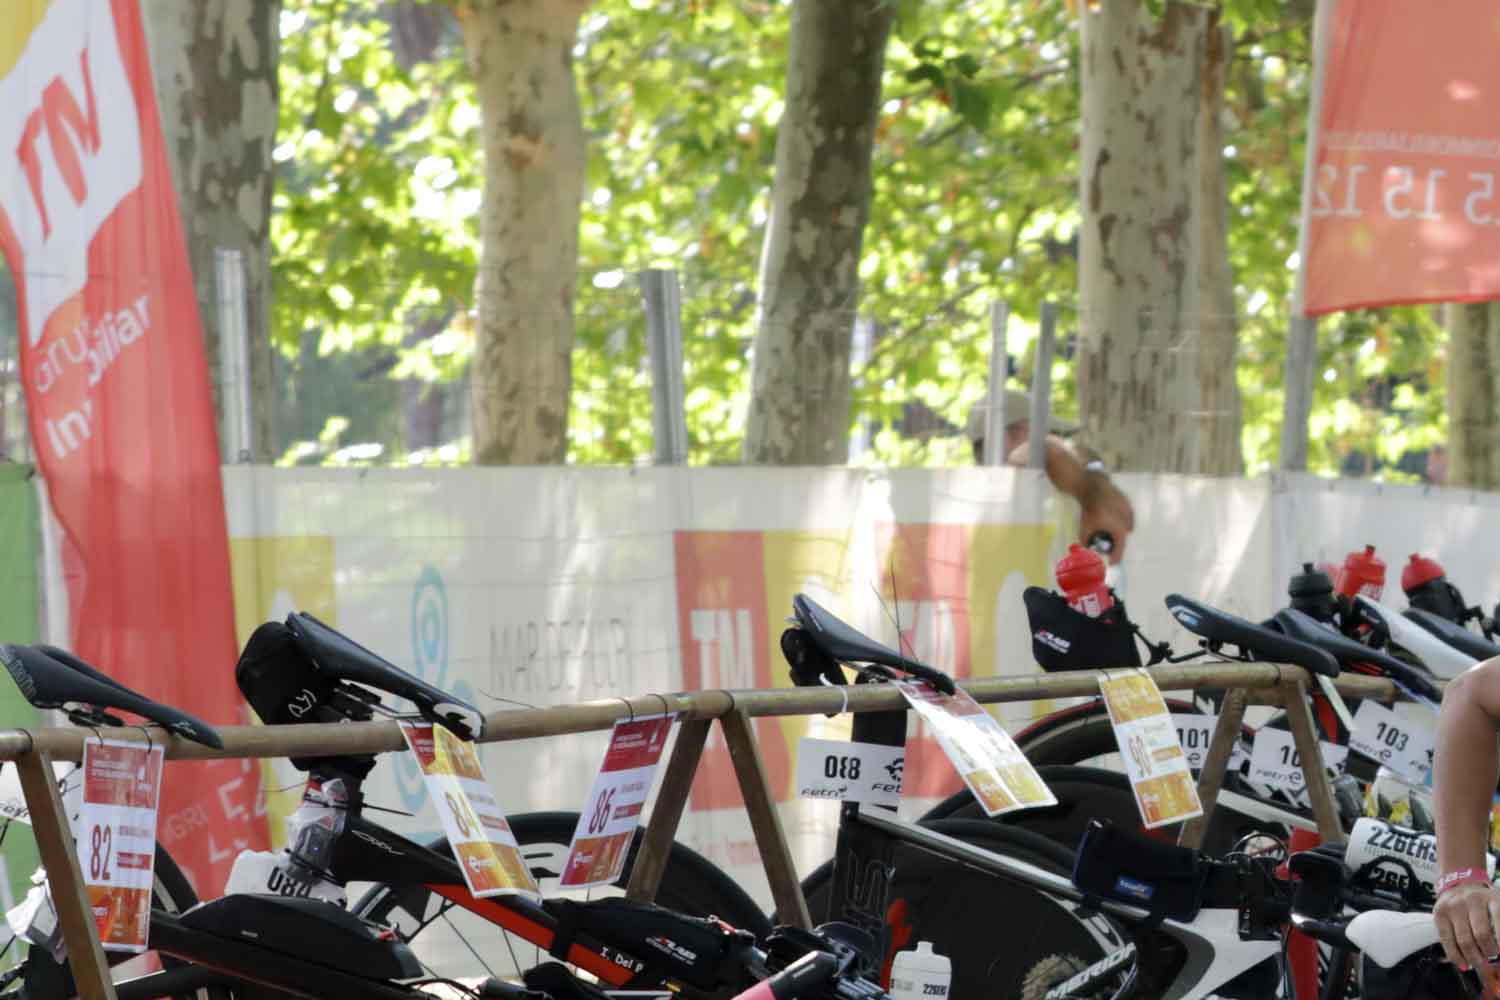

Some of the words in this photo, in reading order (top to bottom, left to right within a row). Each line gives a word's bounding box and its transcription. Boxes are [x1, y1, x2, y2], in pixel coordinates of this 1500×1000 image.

[1177, 728, 1209, 749] 101
[1375, 722, 1409, 752] 103
[588, 786, 616, 835] 86
[90, 824, 112, 881] 82
